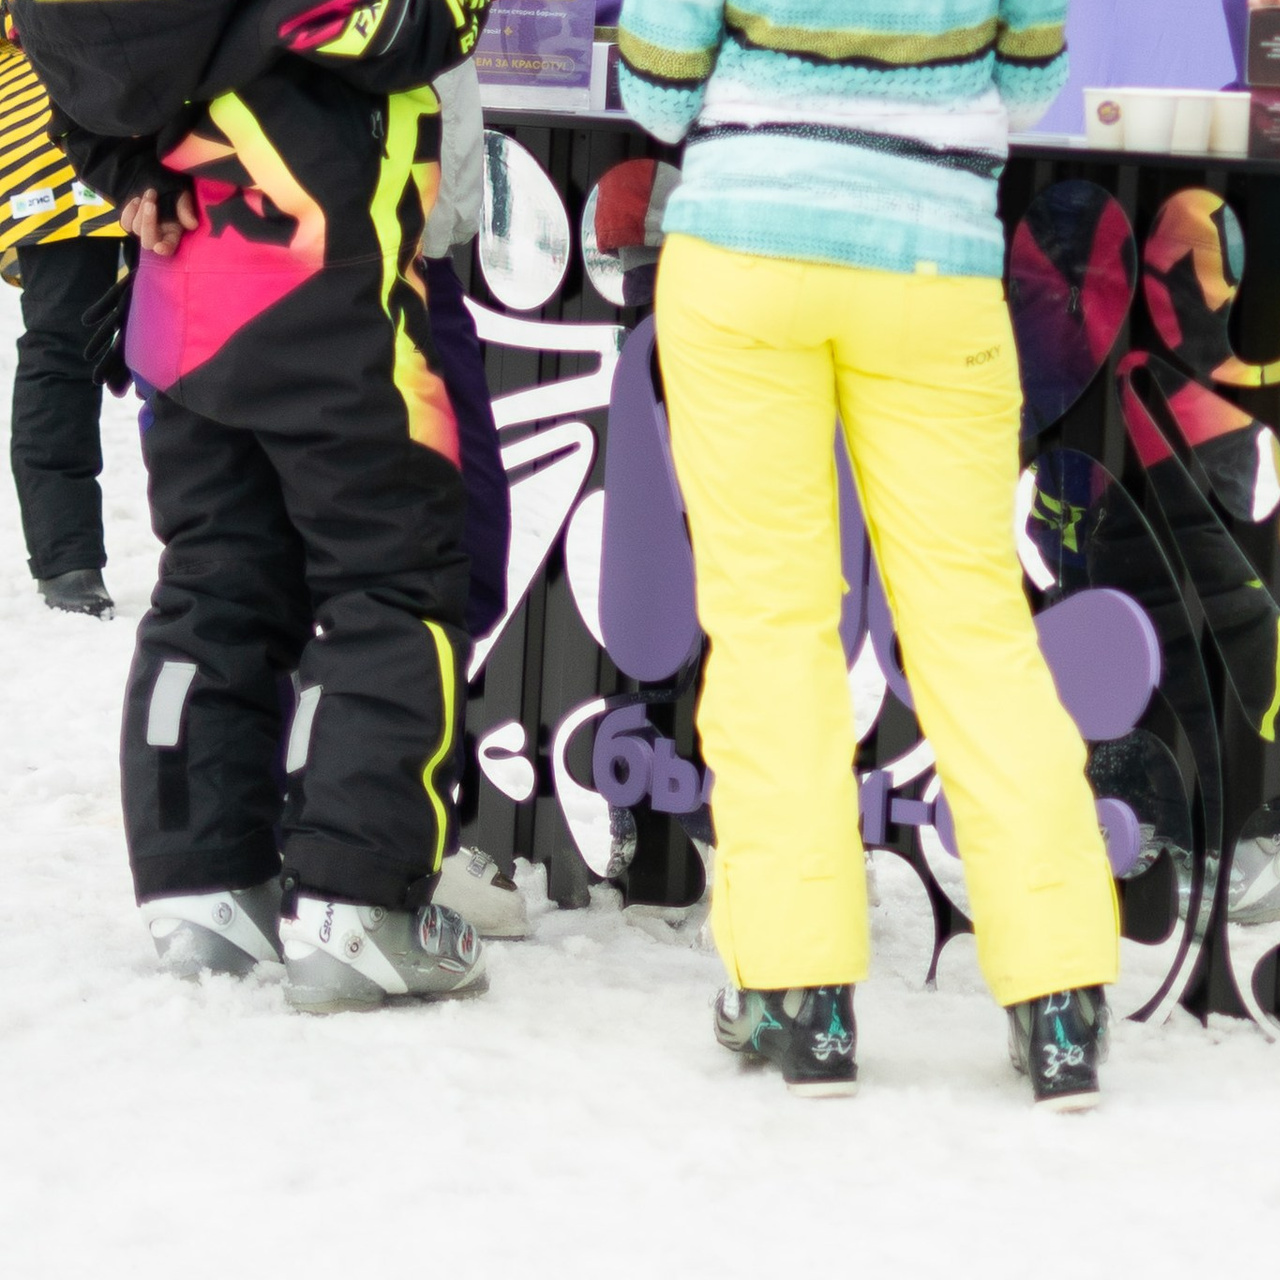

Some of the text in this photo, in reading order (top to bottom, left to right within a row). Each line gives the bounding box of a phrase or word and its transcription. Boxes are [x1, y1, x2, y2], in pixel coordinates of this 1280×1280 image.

[476, 57, 493, 68] ЕМ
[495, 58, 509, 69] ЗА
[966, 345, 1001, 368] ROXY
